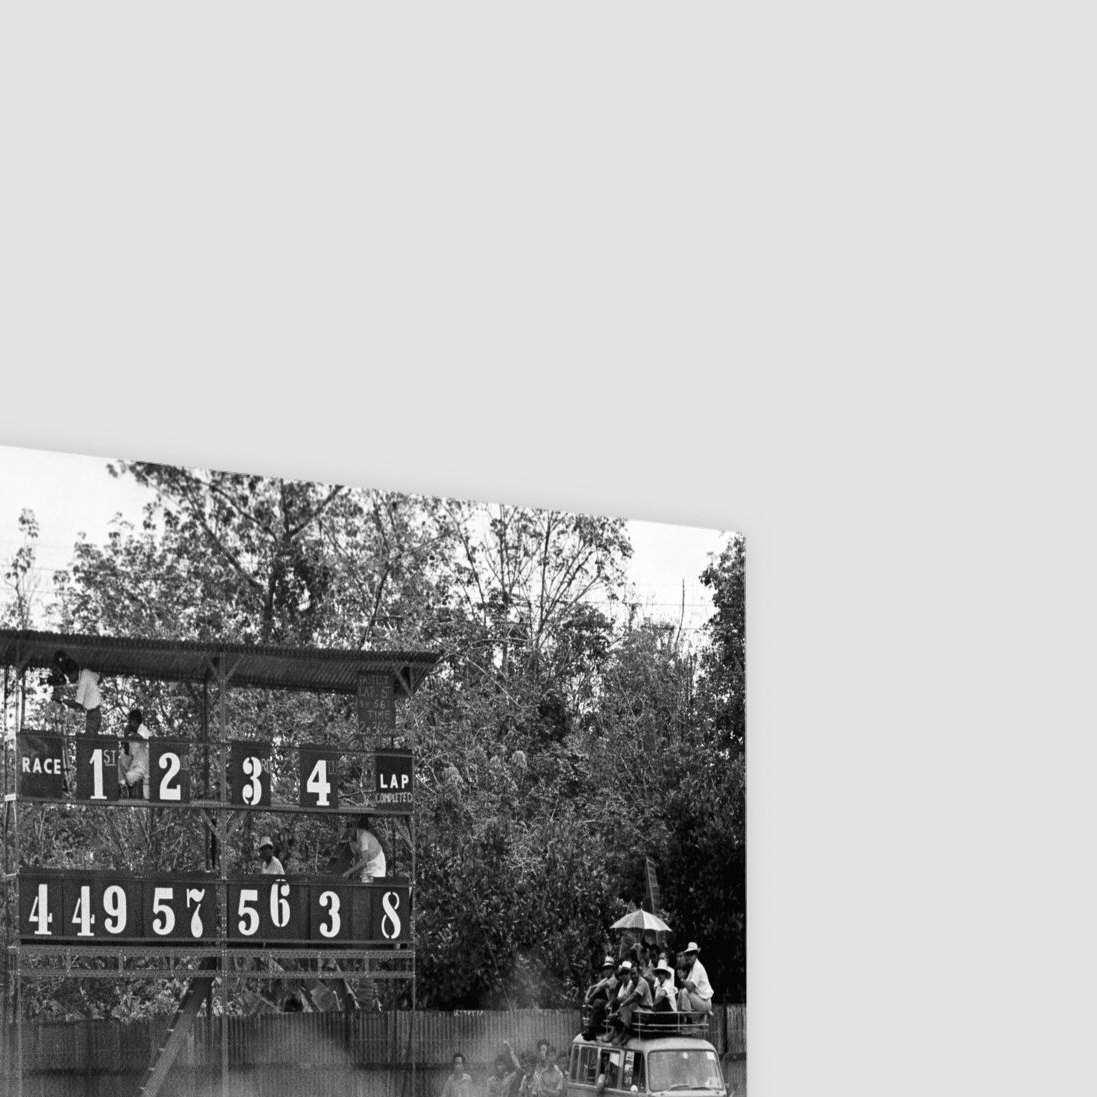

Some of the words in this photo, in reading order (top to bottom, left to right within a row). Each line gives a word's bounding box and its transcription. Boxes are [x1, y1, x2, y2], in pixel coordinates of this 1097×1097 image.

[22, 757, 61, 775] RACE
[380, 773, 409, 789] LAP
[29, 883, 53, 935] 4
[72, 885, 127, 936] 49
[319, 890, 341, 938] 3
[381, 891, 402, 939] 8
